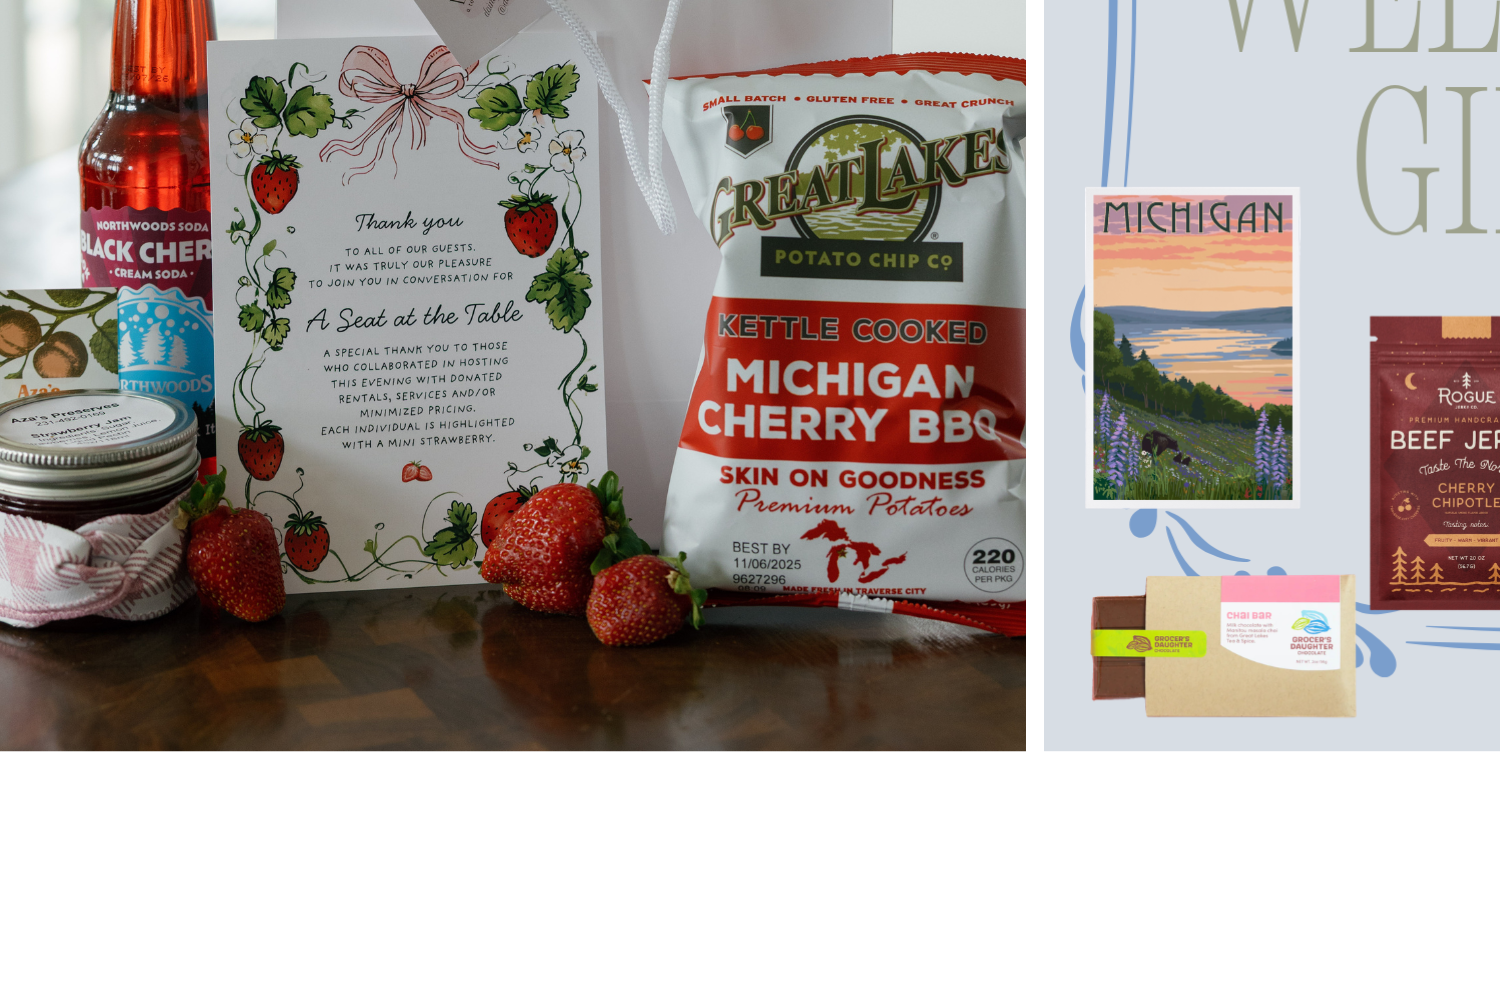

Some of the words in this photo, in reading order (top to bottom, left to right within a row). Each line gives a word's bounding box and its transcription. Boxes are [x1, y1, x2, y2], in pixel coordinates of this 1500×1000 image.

[702, 95, 741, 112] SMALL
[806, 95, 858, 103] GLUTEN
[861, 96, 895, 105] FREE
[914, 98, 958, 109] GREAT
[961, 97, 1015, 108] CRUNCH
[709, 155, 865, 249] GREAT
[355, 211, 417, 232] Thank
[422, 216, 464, 235] you
[1103, 201, 1283, 233] MICHIGAN
[97, 221, 176, 232] NORTHWOODS
[178, 222, 209, 232] SODA
[81, 229, 134, 263] BLACK
[432, 243, 476, 253] GUESTS.
[373, 261, 409, 271] TRULY
[438, 257, 492, 268] PLEASURE
[775, 249, 862, 267] POTATO
[868, 252, 920, 269] CHIP
[114, 268, 152, 279] CREAM
[155, 269, 188, 279] SODA
[328, 278, 355, 287] JOIN
[402, 273, 489, 284] CONVERSATION
[306, 308, 330, 332] A
[336, 307, 388, 332] Seat
[393, 307, 417, 327] at
[422, 304, 459, 325] the
[464, 300, 523, 325] Table
[718, 312, 839, 341] KETTLE
[852, 317, 988, 345] COOKED
[335, 347, 379, 358] SPECIAL
[384, 345, 422, 355] THANK
[472, 341, 508, 351] THOSE
[353, 360, 438, 371] COLLABORATED
[459, 356, 509, 367] HOSTING
[331, 379, 357, 388] THIS
[361, 376, 412, 388] EVENING
[416, 375, 446, 384] WITH
[450, 372, 503, 383] DONATED
[727, 357, 975, 400] MICHIGAN
[339, 392, 392, 404] RENTALS,
[396, 390, 448, 401] SERVICES
[451, 387, 496, 398] AND/OR
[11, 416, 48, 424] Aza's
[51, 403, 119, 418] Preserves
[360, 406, 424, 418] MINIMIZED
[428, 404, 476, 415] PRICING.
[31, 423, 100, 438] Strawberry
[106, 415, 131, 424] Jam
[321, 426, 350, 436] EACH
[355, 422, 420, 434] INDIVIDUAL
[439, 417, 515, 429] HIGHLIGHTED
[698, 400, 889, 443] CHERRY
[909, 408, 999, 444] BBQ
[341, 440, 372, 450] WITH
[388, 438, 415, 448] MINI
[420, 434, 496, 446] STRAWBERRY.
[1391, 430, 1454, 450] BEEF
[1419, 458, 1450, 476] Taste
[1454, 456, 1475, 469] The
[719, 465, 779, 486] SKIN
[789, 469, 829, 488] ON
[838, 469, 986, 490] GOODNESS
[1438, 483, 1495, 494] CHERRY
[734, 488, 856, 516] Premium
[866, 491, 974, 517] Potatoes
[1432, 498, 1500, 508] CHIPOTLE
[732, 541, 767, 555] BEST
[772, 543, 791, 555] BY
[733, 557, 802, 571] 11/06/2025
[972, 549, 1016, 565] 220
[971, 565, 1016, 575] CALORIES
[732, 573, 787, 585] 9627296
[974, 575, 994, 584] PER
[995, 574, 1013, 583] PKG
[856, 587, 903, 595] TRAVERSE
